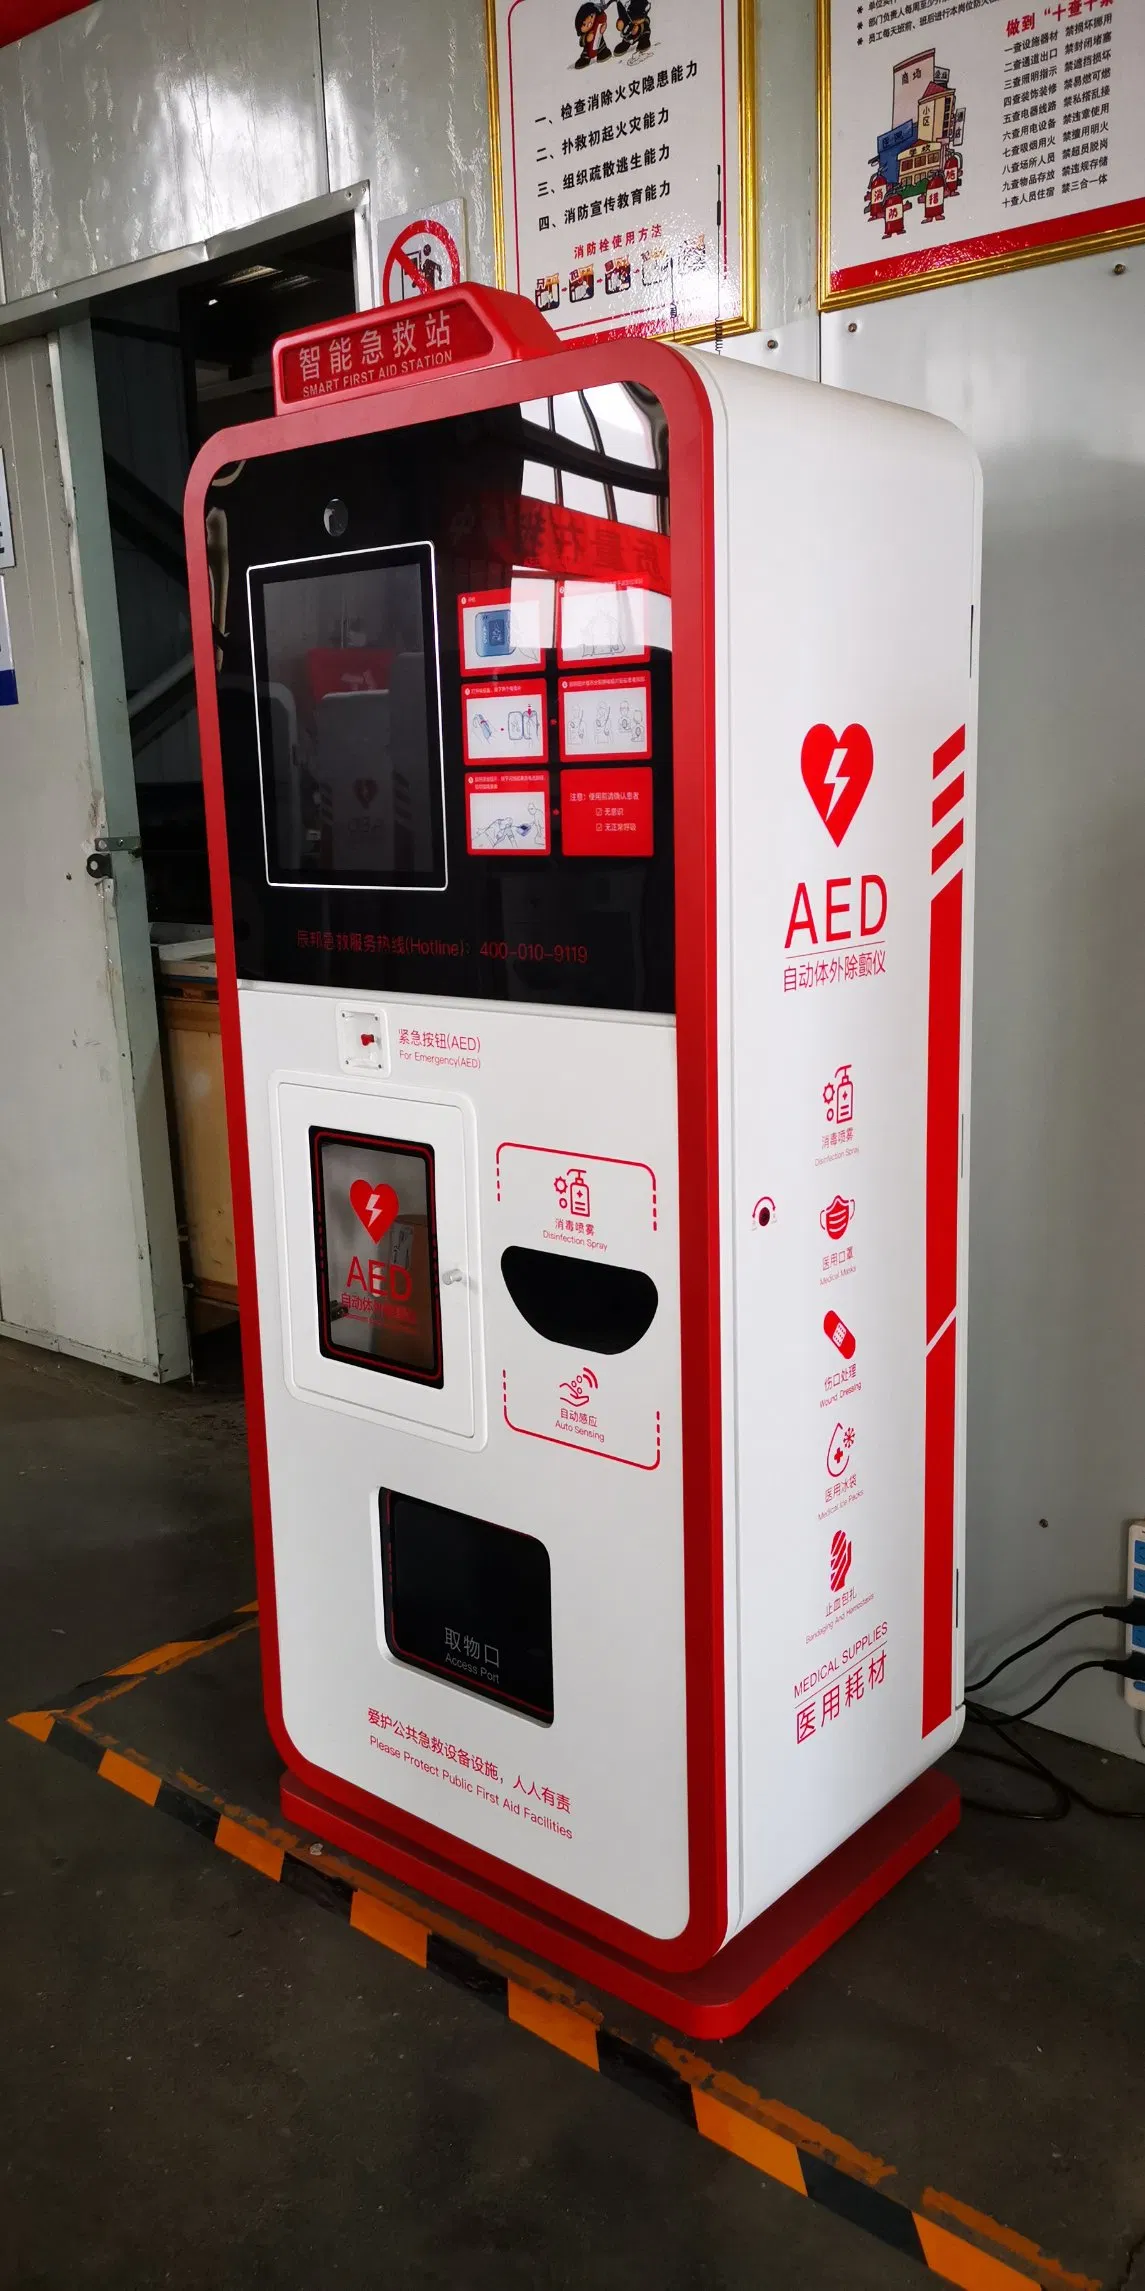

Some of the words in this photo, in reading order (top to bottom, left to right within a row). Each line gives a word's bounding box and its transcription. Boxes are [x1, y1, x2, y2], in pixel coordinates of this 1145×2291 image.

[1004, 29, 1058, 54] 一查设施器材
[1003, 48, 1058, 73] 二查通道出口
[535, 60, 698, 124] 一、检查消除火灾隐患能力
[1003, 65, 1057, 91] 三查照明指示
[1003, 82, 1057, 108] 四查装饰装修
[922, 106, 931, 127] 小区
[1002, 100, 1057, 125] 五查电器线路
[536, 107, 669, 162] 二、扑救初起火灾能力
[1002, 118, 1056, 142] 六查用电设备
[1002, 135, 1056, 158] 七查吸烟用火
[537, 143, 670, 198] 三、组织疏散逃生能力
[1002, 152, 1055, 176] 八查场所人员
[1002, 169, 1055, 193] 九查物品存放
[538, 180, 671, 232] 四、消防宣传教育能力
[1002, 186, 1055, 209] 十查人员住宿
[573, 224, 663, 260] 消防栓使用方法
[299, 309, 451, 383] 智能急救站
[302, 379, 340, 398] SMART
[343, 370, 375, 388] FIRST
[378, 363, 398, 380] AID
[401, 349, 453, 374] STATION
[784, 874, 888, 949] AED
[479, 941, 589, 964] 400-010-9119
[783, 949, 886, 993] 自动体外除颤仪
[398, 1028, 481, 1053] 紧急按钮(AED)
[399, 1050, 412, 1060] For
[414, 1051, 481, 1070] Emergency(AED)
[555, 1217, 594, 1236] 消毒喷雾
[542, 1229, 585, 1245] Disinfection
[586, 1238, 608, 1253] Spray
[822, 1245, 854, 1271] 医用口罩
[346, 1255, 413, 1302] AED
[341, 1291, 417, 1325] 自动体外
[824, 1363, 856, 1392] 伤口处理
[819, 1393, 838, 1409] Wound
[839, 1381, 862, 1399] Dressing
[555, 1419, 573, 1432] Auto
[574, 1425, 605, 1443] Sensing
[560, 1407, 598, 1428] 自动感应
[825, 1586, 858, 1618] 止血包扎
[443, 1627, 500, 1669] 取物口
[793, 1657, 840, 1699] MEDICAL
[842, 1621, 889, 1664] SUPPLIES
[445, 1653, 478, 1677] Access
[480, 1666, 500, 1685] Port
[796, 1648, 887, 1745] 医用耗材
[367, 1706, 571, 1815] 爱护公共急救设备设施，人人有责
[369, 1734, 401, 1759] Please
[403, 1750, 440, 1778] Protect
[442, 1769, 474, 1793] Public
[476, 1785, 500, 1806] First
[503, 1797, 520, 1816] Aid
[523, 1806, 574, 1840] Facilities
